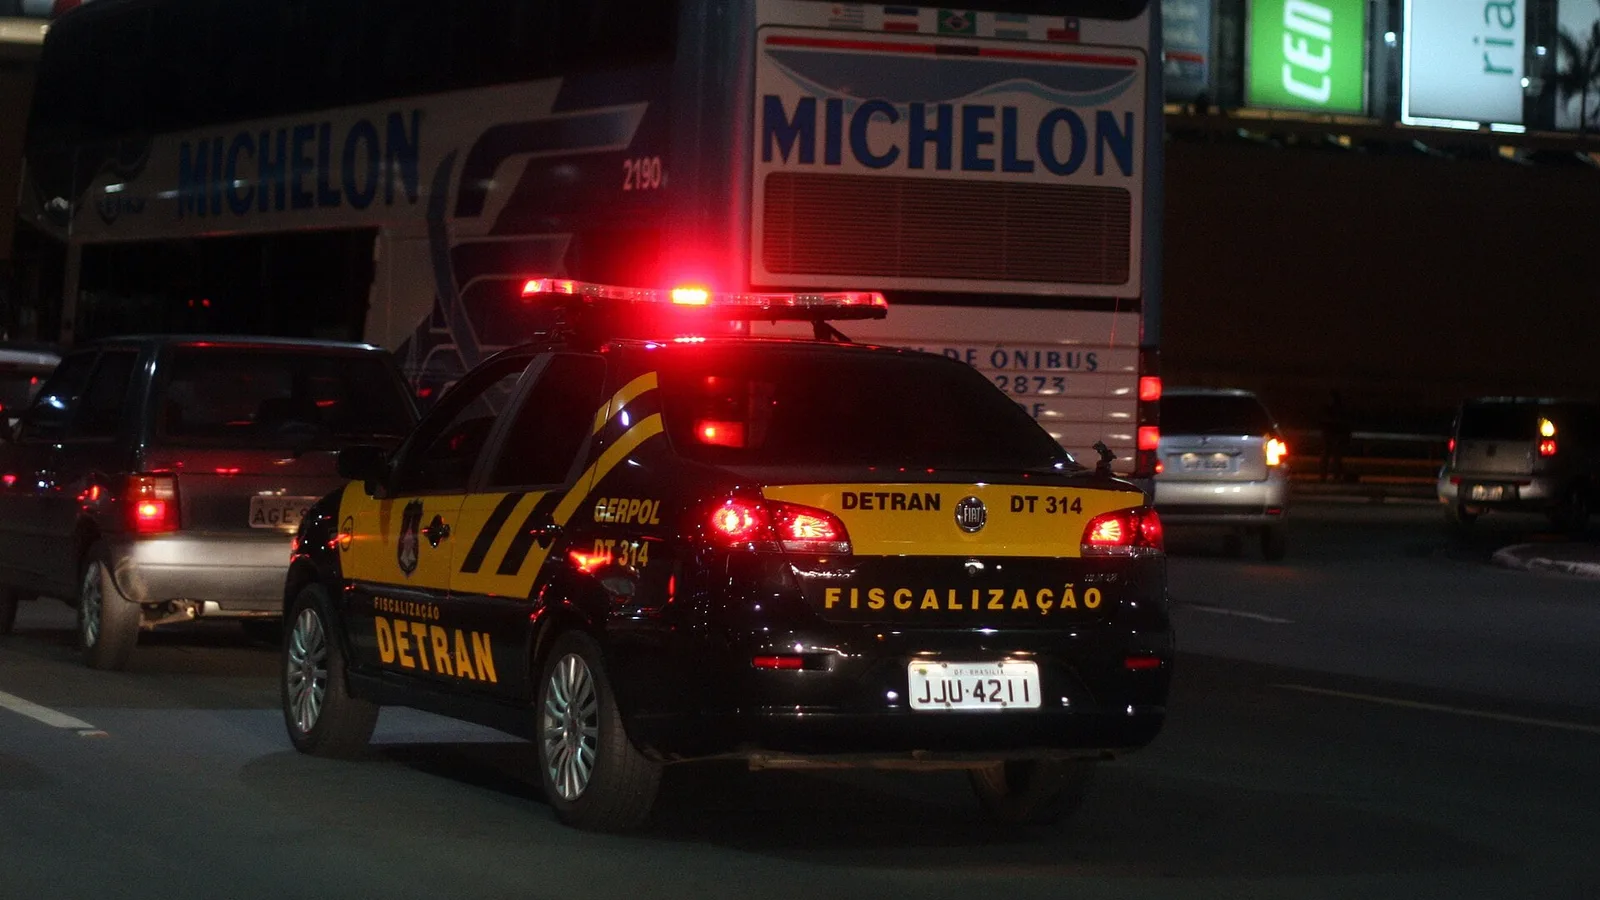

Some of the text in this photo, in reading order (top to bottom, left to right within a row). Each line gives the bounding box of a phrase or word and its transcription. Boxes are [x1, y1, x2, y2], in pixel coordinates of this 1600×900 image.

[1474, 0, 1516, 75] ria
[762, 95, 1134, 177] MICHELON
[178, 109, 422, 219] MICHELON
[622, 156, 661, 191] 2190
[990, 344, 1098, 372] ÔNIBUS
[593, 496, 661, 525] GERPOL
[841, 492, 941, 512] DETRAN
[963, 506, 981, 523] FIAT
[1010, 494, 1083, 515] DT 314
[592, 538, 650, 568] DT 314
[373, 596, 442, 621] FISCALIZAÇÃO
[824, 582, 1102, 616] FISCALIZAÇÃO
[374, 615, 499, 684] DETRAN
